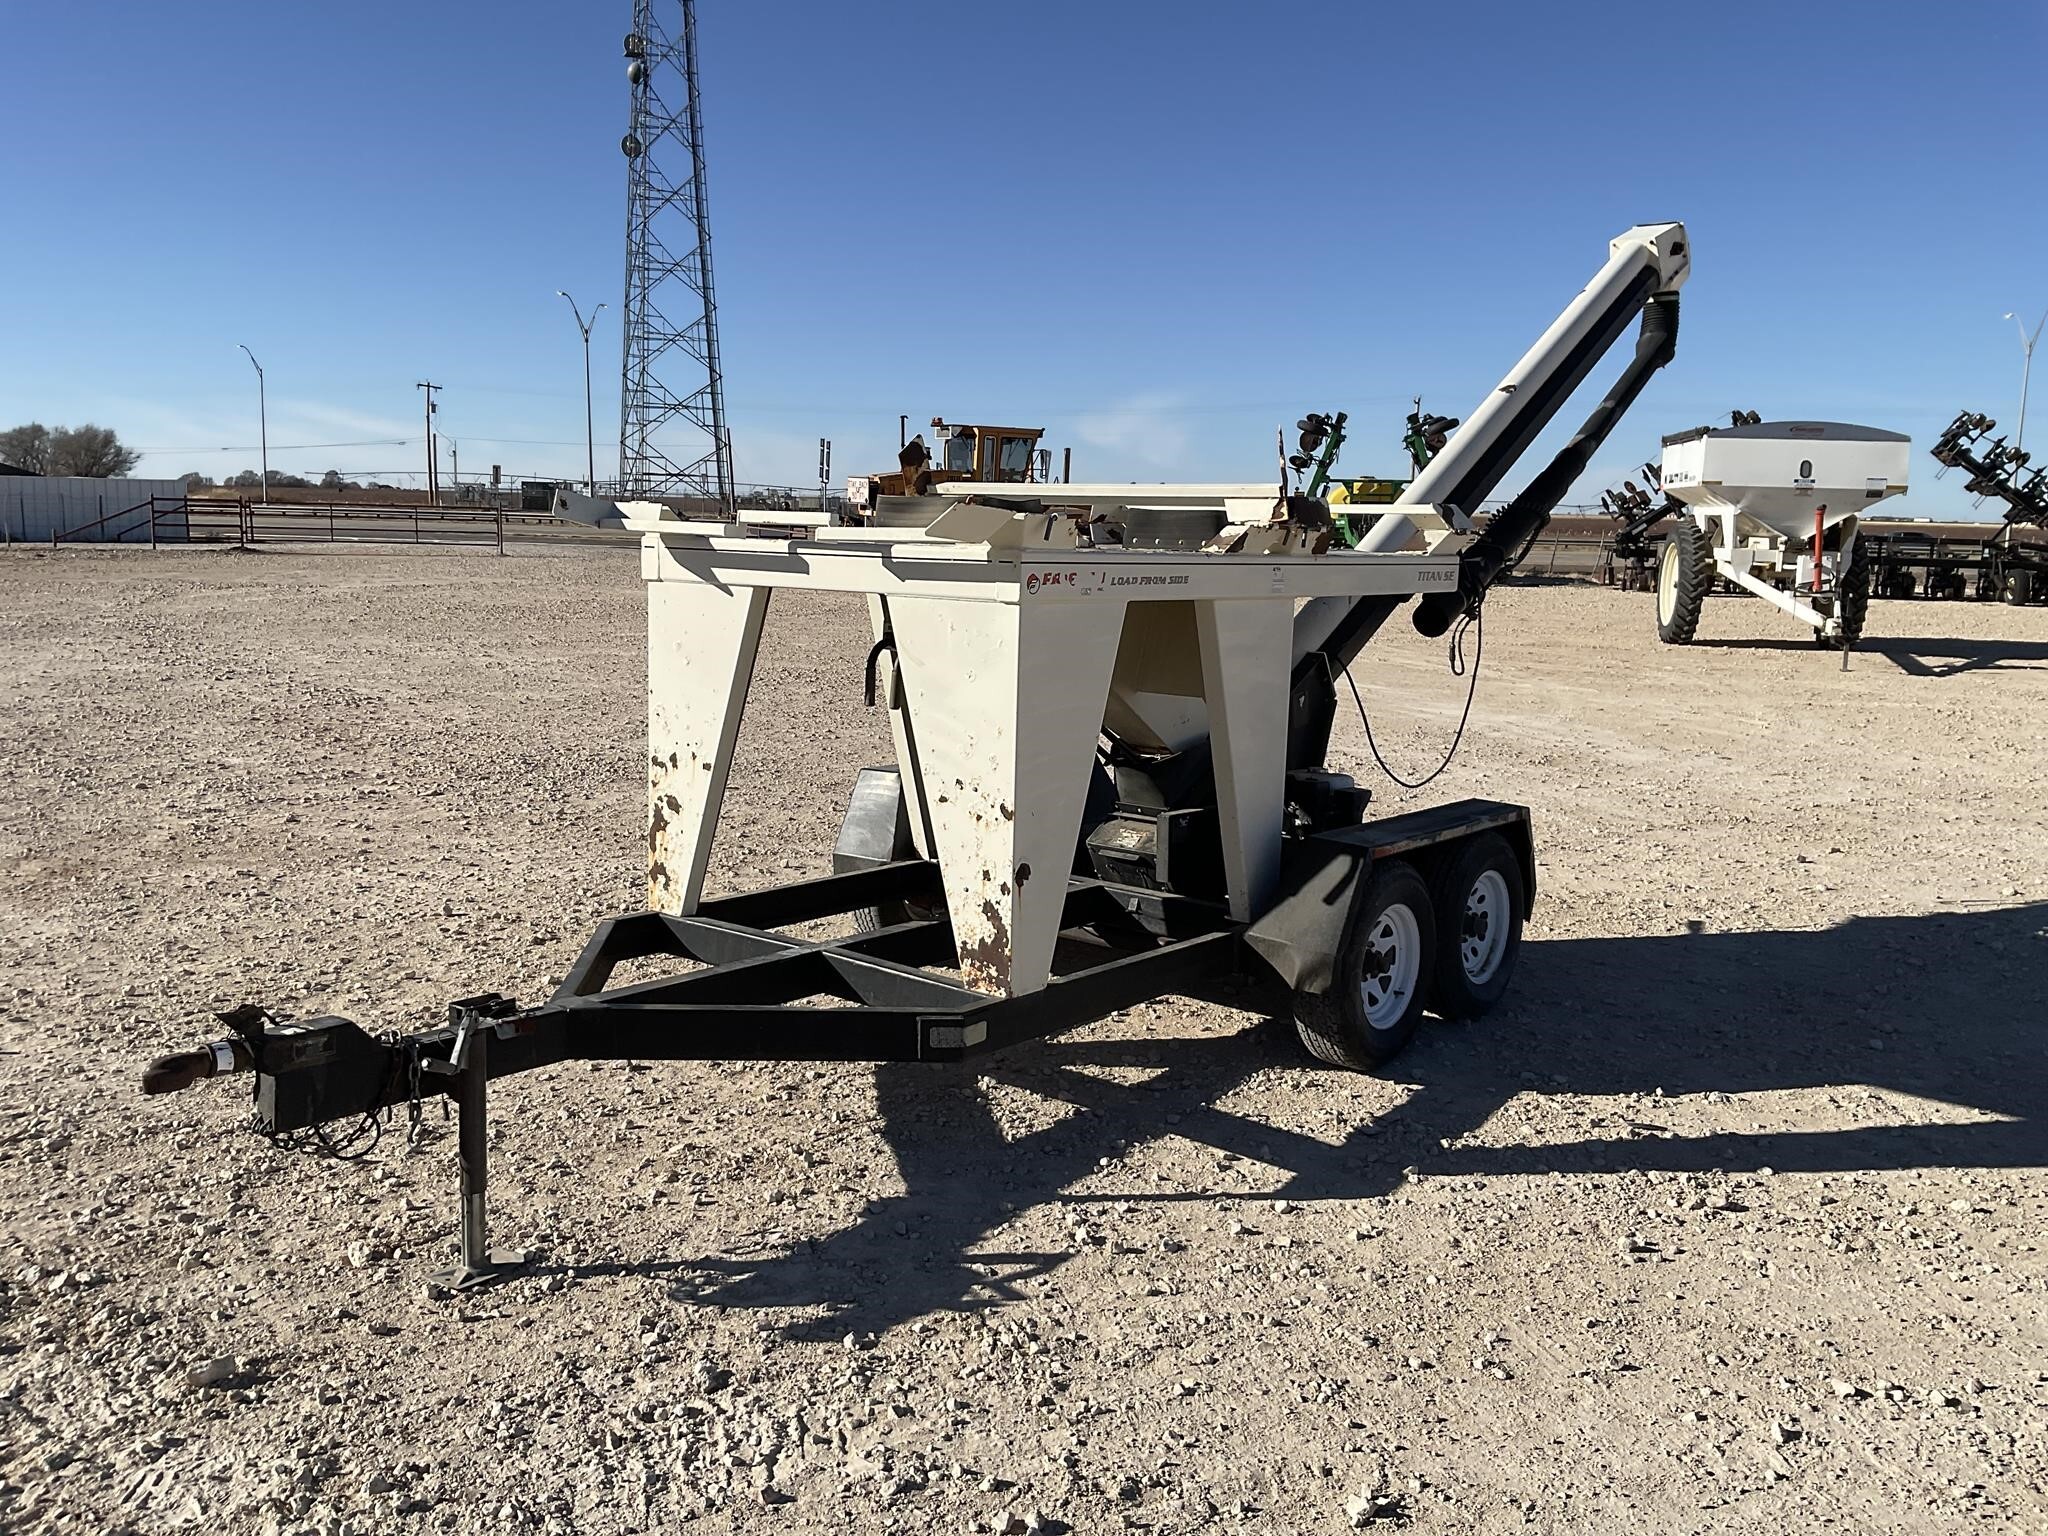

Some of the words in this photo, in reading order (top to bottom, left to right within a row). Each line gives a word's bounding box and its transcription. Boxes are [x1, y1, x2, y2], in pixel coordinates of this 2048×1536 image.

[1110, 576, 1138, 586] LOAD
[1139, 576, 1167, 585] FROM
[1167, 575, 1190, 585] SIDE
[1417, 571, 1443, 581] TITAN
[1443, 570, 1456, 581] SE
